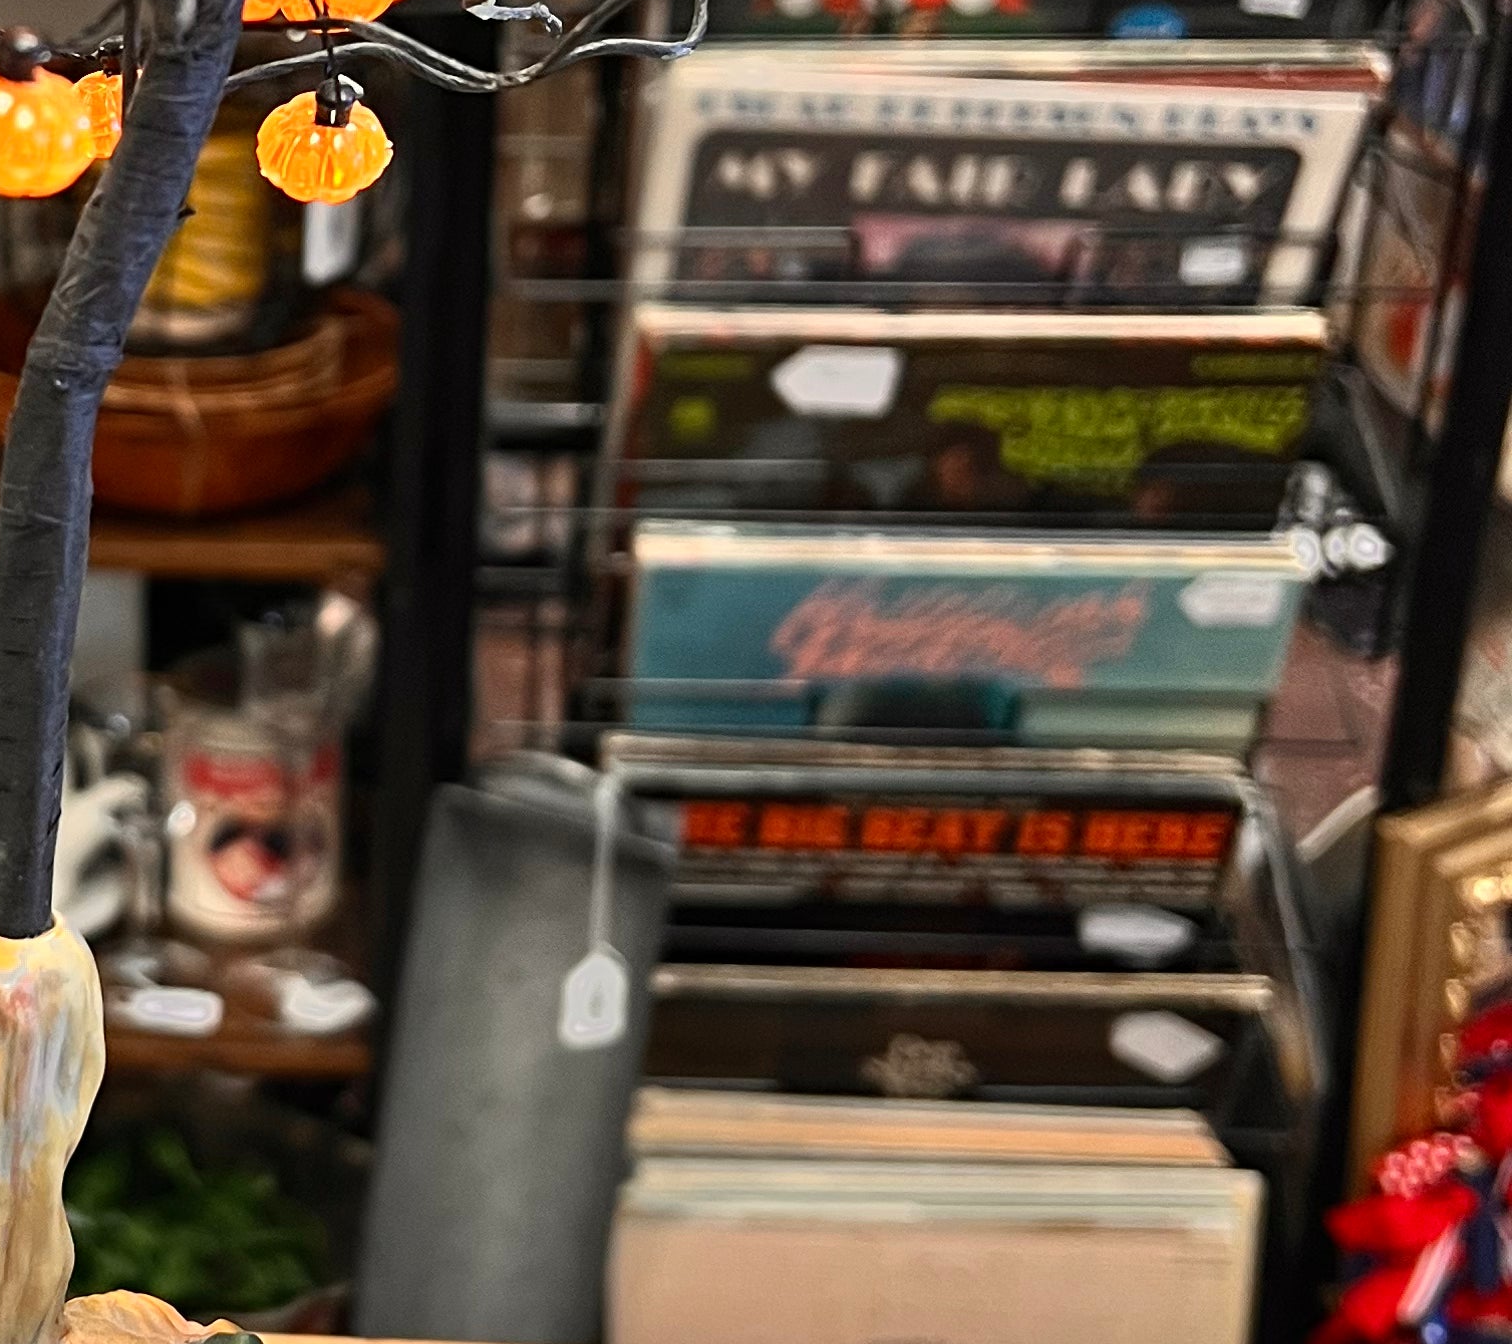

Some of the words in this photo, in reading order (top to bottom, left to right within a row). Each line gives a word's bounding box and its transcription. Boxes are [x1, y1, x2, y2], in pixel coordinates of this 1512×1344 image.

[709, 148, 819, 200] MY
[848, 153, 1041, 209] FAIR
[1059, 158, 1276, 212] LADY
